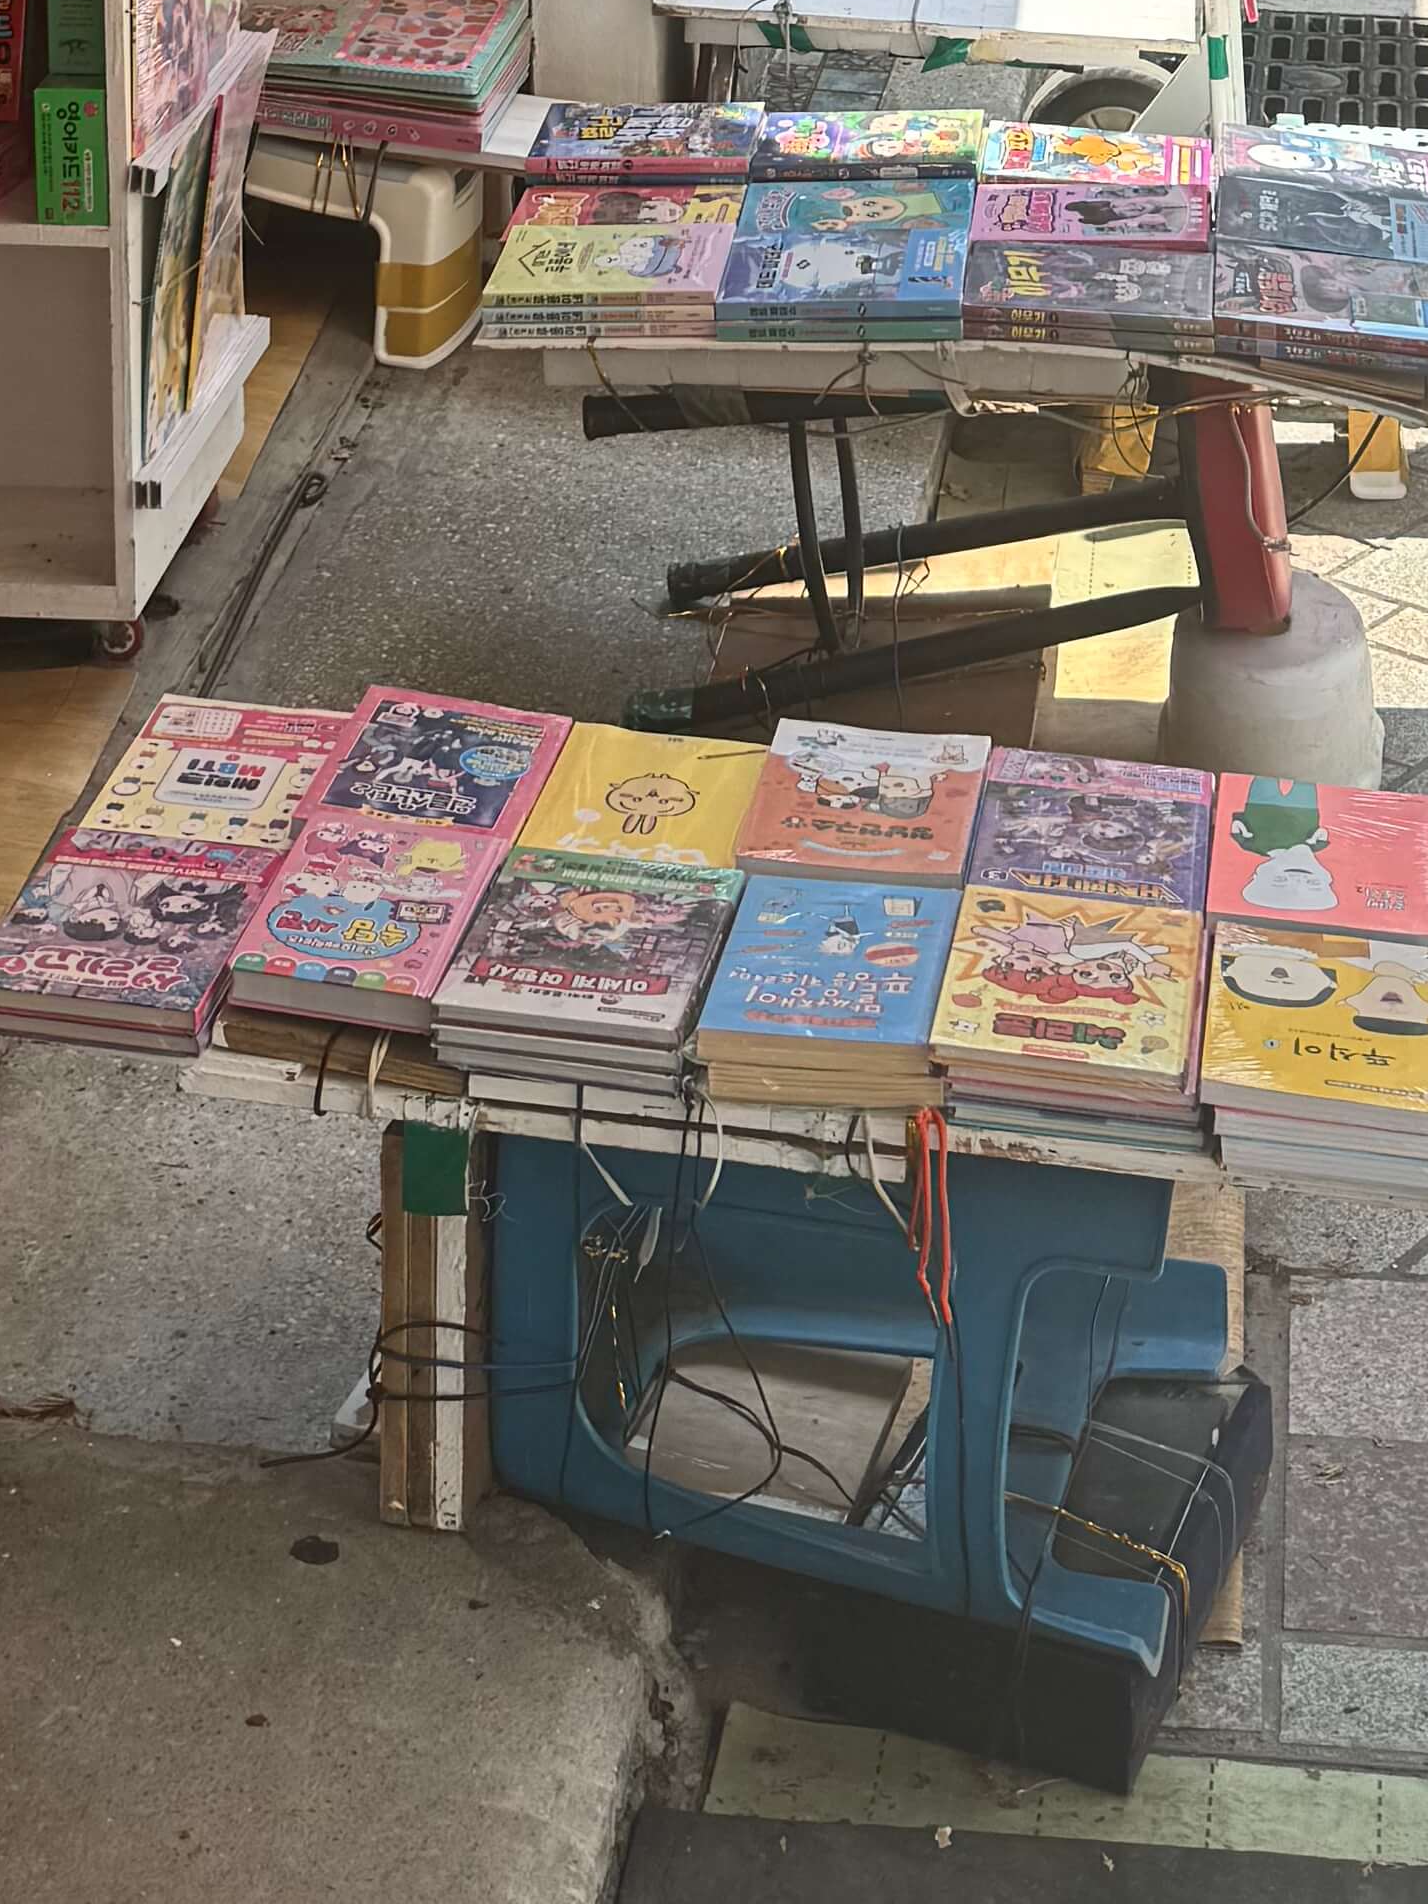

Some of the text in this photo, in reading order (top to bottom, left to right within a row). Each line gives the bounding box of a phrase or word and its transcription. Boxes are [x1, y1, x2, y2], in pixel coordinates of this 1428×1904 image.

[487, 963, 650, 995] 이세계 여행사
[1291, 1036, 1397, 1068] 뚜식이
